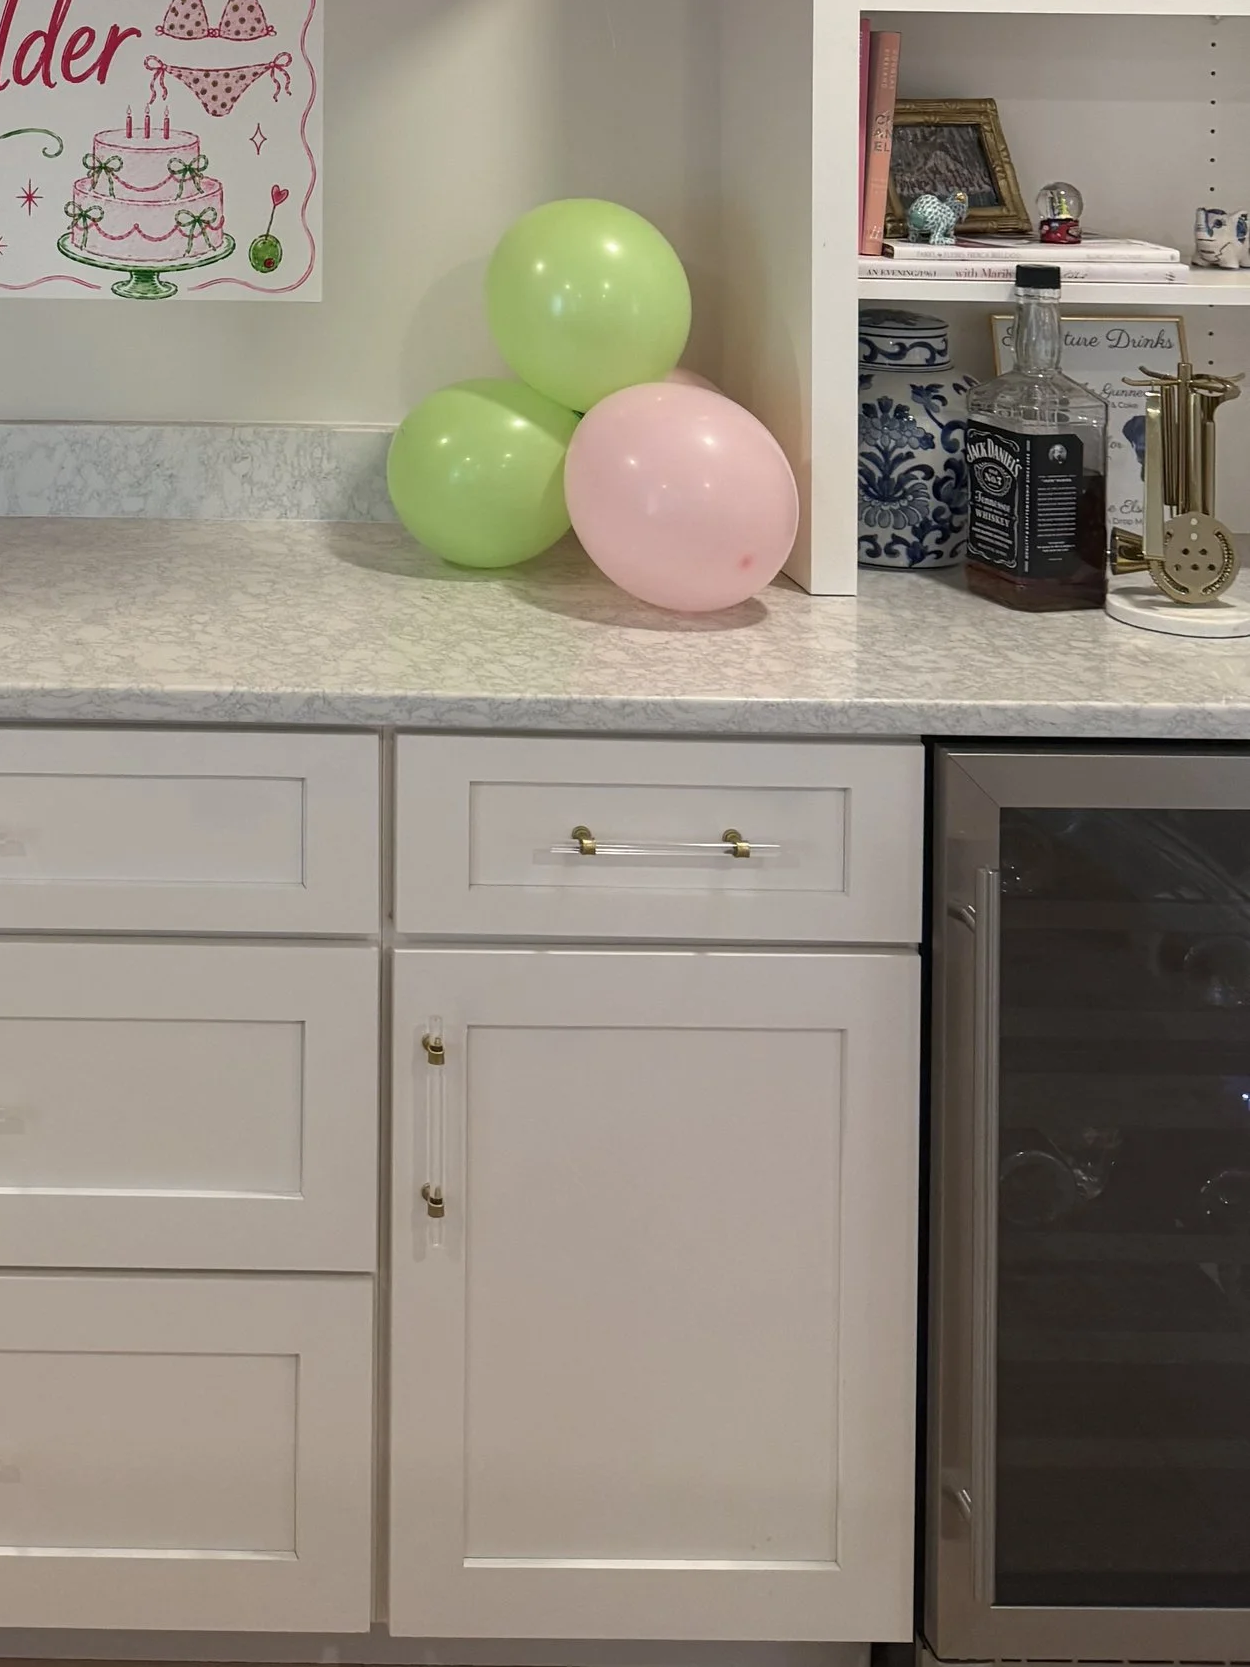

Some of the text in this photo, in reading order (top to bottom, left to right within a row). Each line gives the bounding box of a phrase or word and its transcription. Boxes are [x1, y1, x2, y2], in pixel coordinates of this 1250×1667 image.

[955, 267, 979, 279] with
[1106, 328, 1175, 350] Drinks
[966, 437, 1023, 478] JACK DANIEL'S
[975, 508, 1011, 528] WHISKEY
